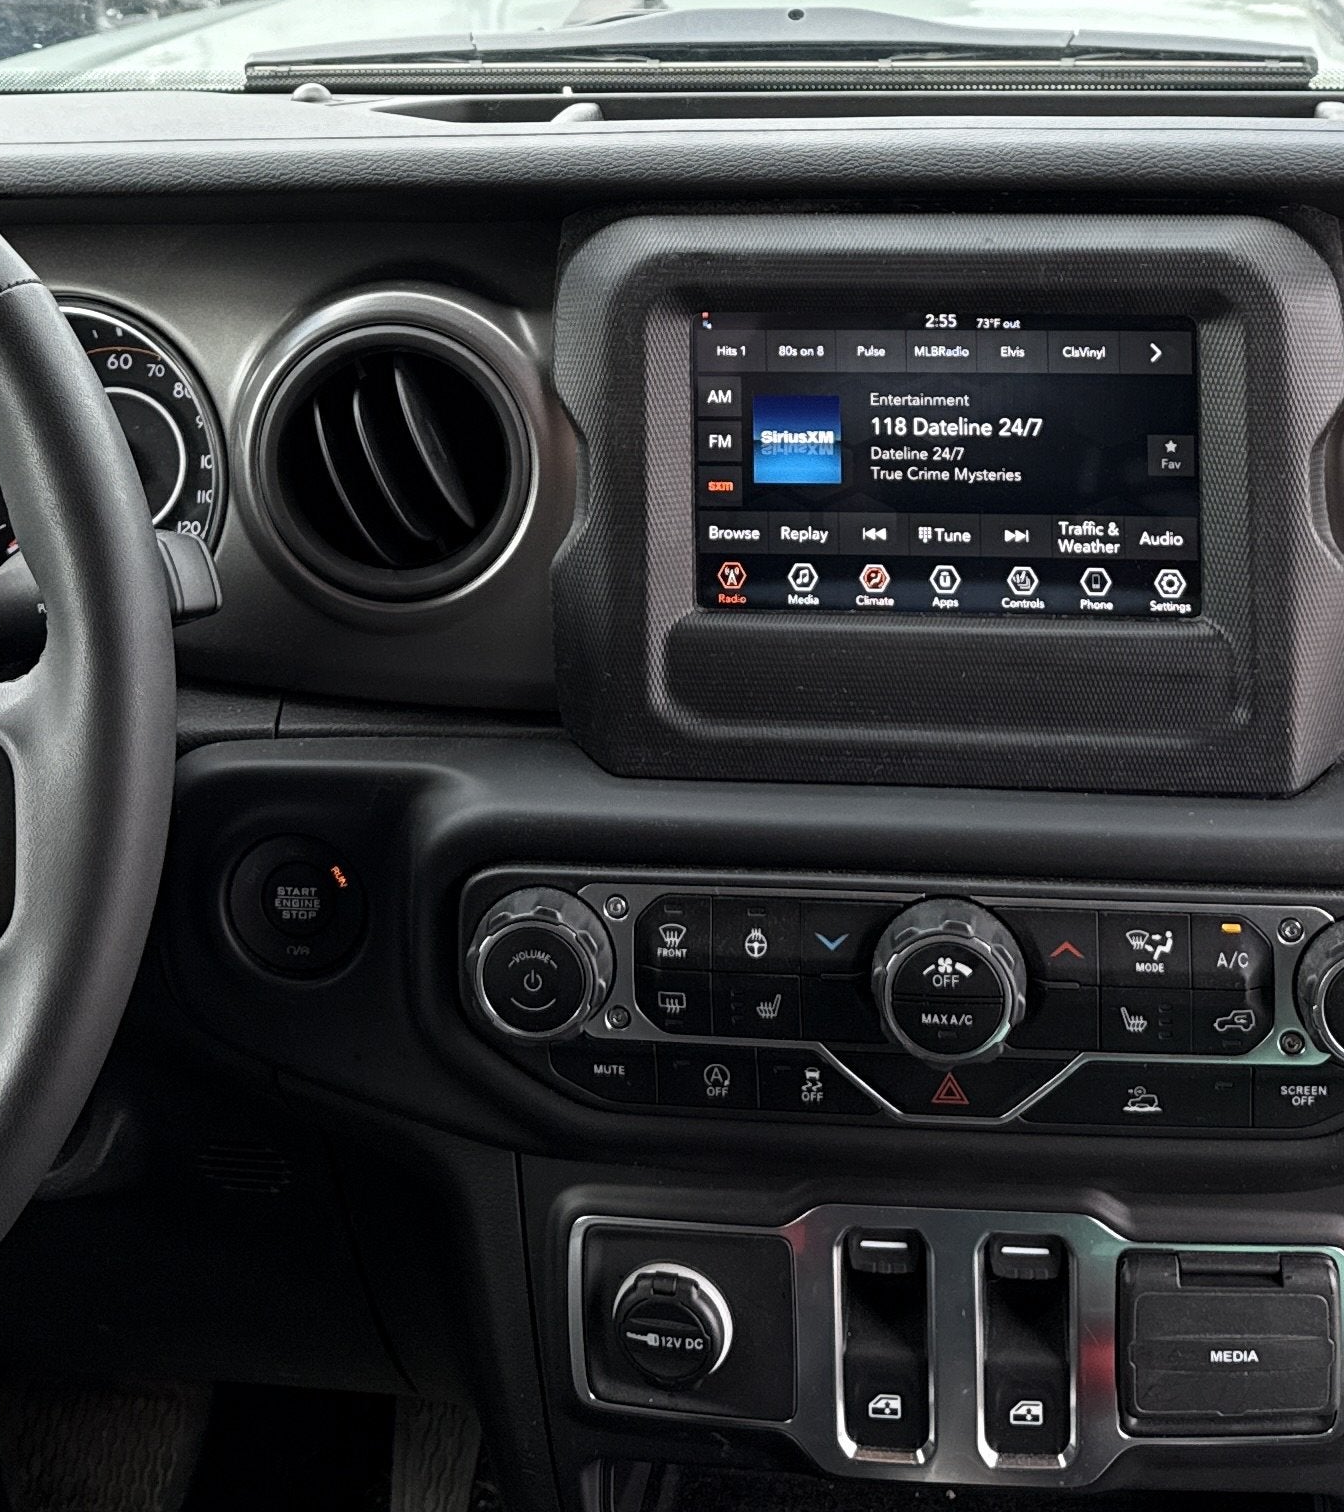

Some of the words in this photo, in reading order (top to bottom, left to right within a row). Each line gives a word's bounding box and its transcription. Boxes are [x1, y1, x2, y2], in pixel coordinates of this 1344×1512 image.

[924, 313, 958, 329] 2:55
[975, 317, 1002, 330] 73°F
[1003, 319, 1022, 330] out
[716, 345, 739, 357] Hits
[778, 345, 799, 357] 80s
[800, 347, 816, 357] on
[817, 345, 825, 357] 8
[856, 345, 887, 358] Pulse
[913, 345, 970, 359] MLBRadio
[1000, 346, 1026, 359] Elvis
[1062, 346, 1107, 361] ClsVinyl
[106, 353, 133, 371] 60
[146, 363, 166, 379] 70
[707, 389, 733, 404] AM
[869, 392, 970, 408] Entertainment
[195, 415, 206, 430] 9
[870, 417, 907, 437] 118
[912, 417, 993, 438] Dateline
[997, 417, 1044, 438] 24/7
[708, 434, 733, 449] FM
[760, 429, 835, 446] SiriusXM
[870, 446, 929, 462] Dateline
[931, 446, 966, 463] 24/7
[200, 454, 213, 470] 10
[1160, 458, 1182, 471] Fav
[869, 466, 905, 481] True
[906, 466, 950, 481] Crime
[953, 467, 1022, 485] Mysteries
[708, 480, 734, 492] sxm
[176, 519, 202, 536] 120
[708, 525, 761, 541] Browse
[1057, 520, 1105, 538] Traffic
[1106, 521, 1121, 538] &
[780, 526, 829, 544] Replay
[935, 527, 972, 543] Tune
[1138, 530, 1184, 547] Audio
[1057, 538, 1121, 555] Weather
[718, 593, 748, 606] Radio
[787, 594, 820, 606] Media
[855, 594, 895, 607] Climate
[932, 596, 959, 610] Apps
[1001, 597, 1046, 610] Controls
[1079, 598, 1114, 612] Phone
[1149, 600, 1192, 614] Settings
[276, 886, 319, 897] START
[274, 897, 322, 909] ENGINE
[281, 909, 318, 920] STOP
[511, 948, 552, 964] VOLUME
[656, 947, 688, 959] FRONT
[1216, 951, 1250, 970] A/C
[1135, 962, 1166, 974] MODE
[931, 974, 960, 988] OFF
[921, 1013, 948, 1025] MAX
[949, 1013, 974, 1026] A/C
[593, 1063, 626, 1076] MUTE
[706, 1085, 730, 1098] OFF
[801, 1091, 825, 1103] OFF
[1280, 1085, 1328, 1097] SCREEN
[1291, 1095, 1316, 1107] OFF
[660, 1335, 683, 1349] 12V
[684, 1337, 705, 1351] DC
[1209, 1349, 1260, 1364] MEDIA
